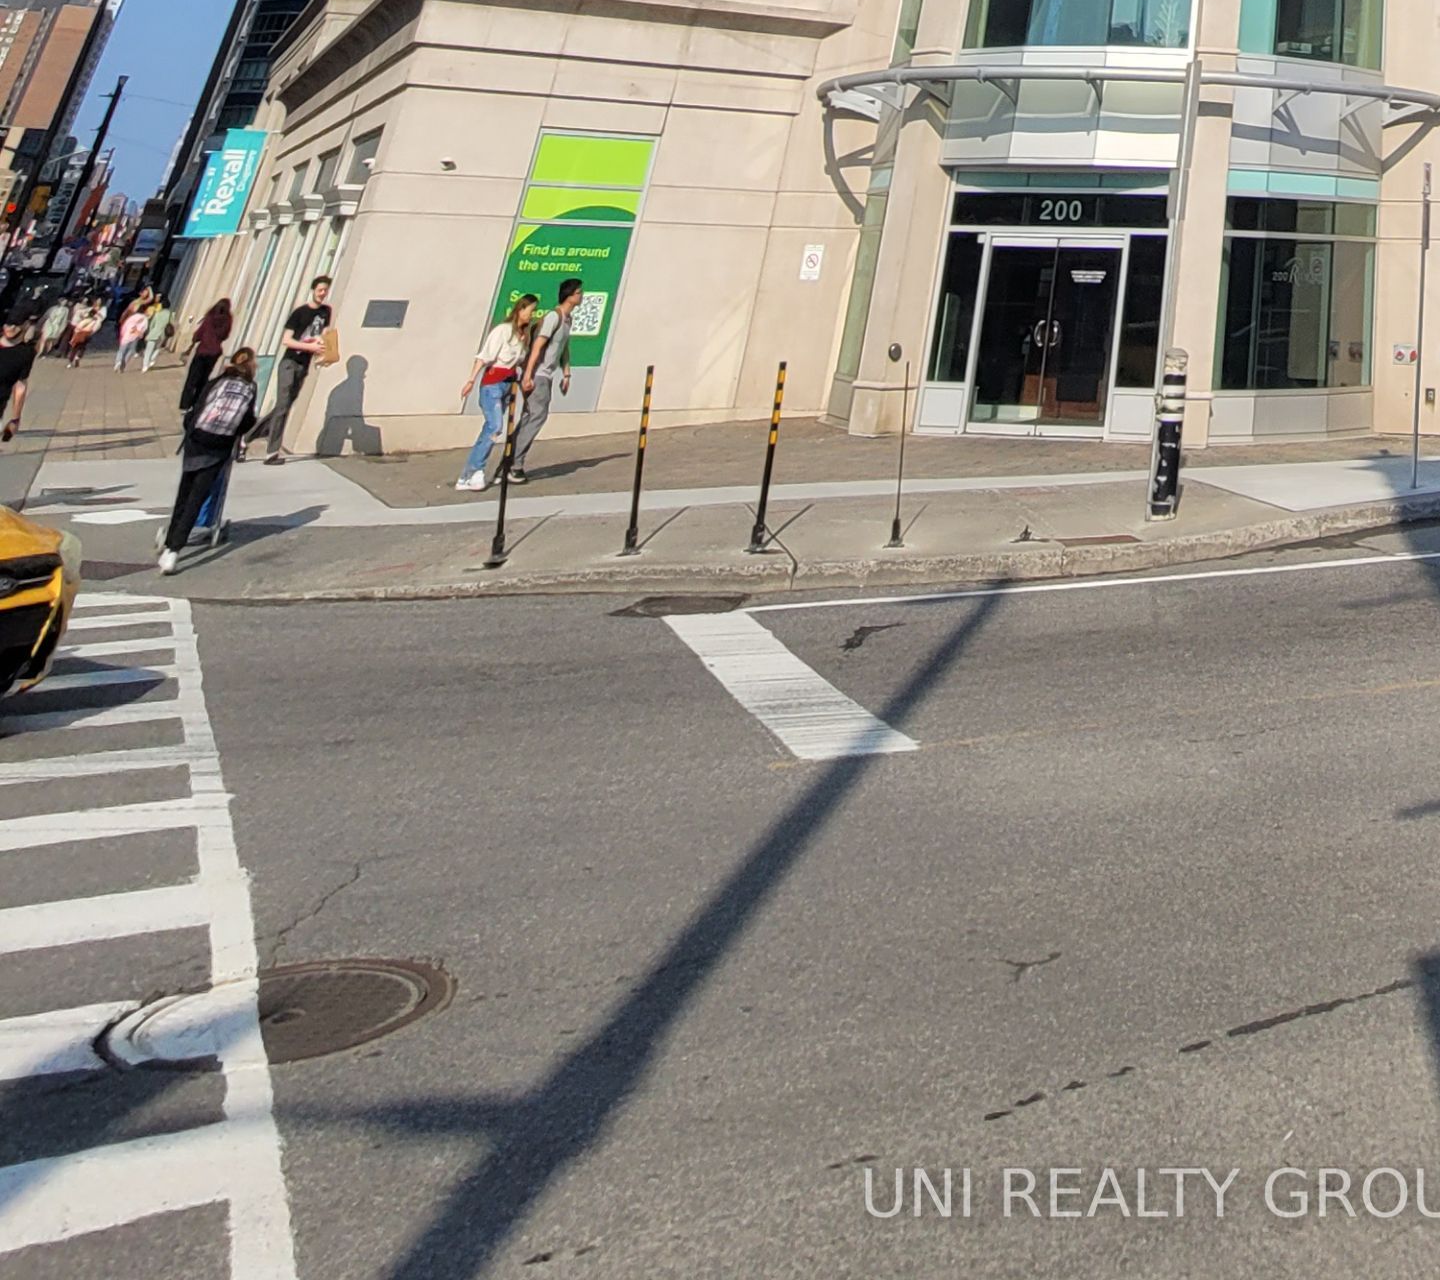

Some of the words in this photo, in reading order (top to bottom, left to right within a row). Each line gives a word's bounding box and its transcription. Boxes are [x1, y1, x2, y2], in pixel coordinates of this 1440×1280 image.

[204, 149, 248, 215] Rexall
[1039, 200, 1082, 220] 200
[523, 244, 550, 256] Find
[551, 247, 566, 256] us
[567, 247, 611, 258] around
[519, 260, 539, 271] the
[541, 262, 582, 272] corner.
